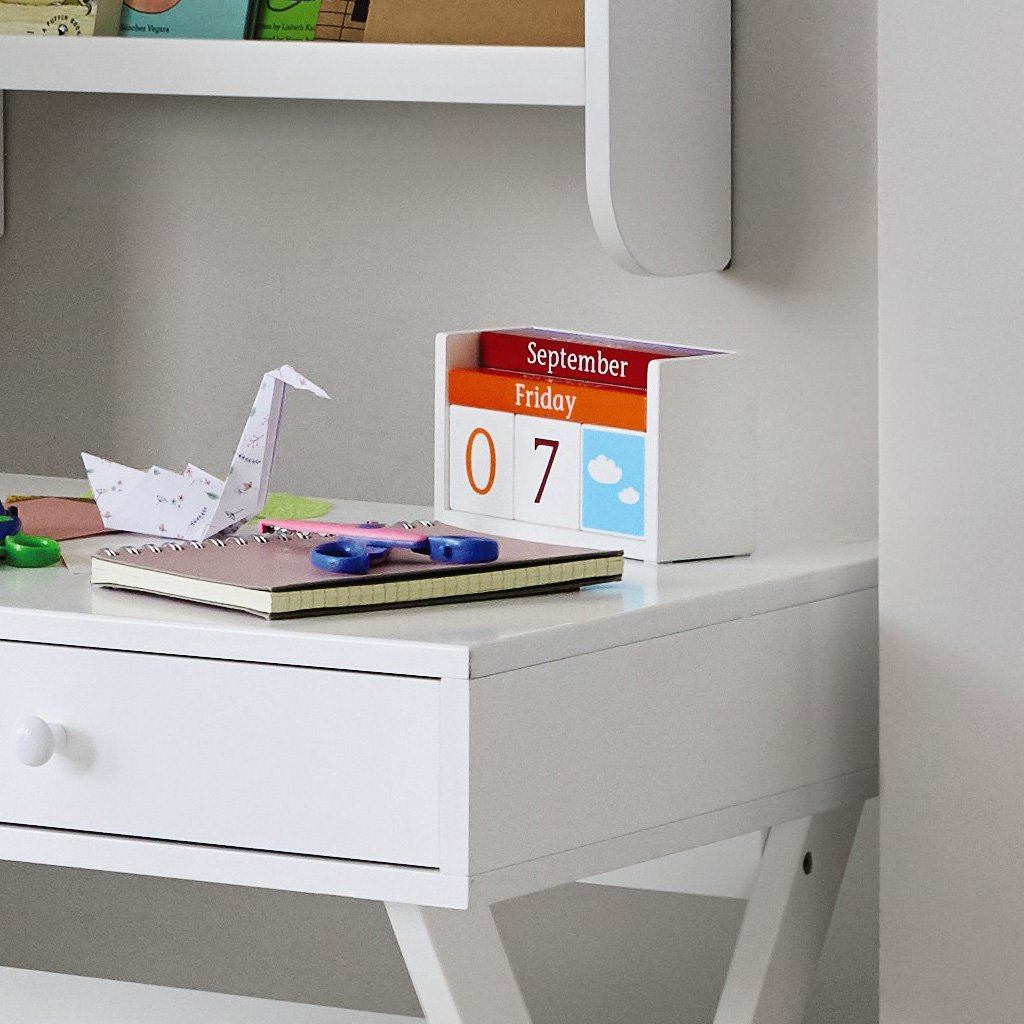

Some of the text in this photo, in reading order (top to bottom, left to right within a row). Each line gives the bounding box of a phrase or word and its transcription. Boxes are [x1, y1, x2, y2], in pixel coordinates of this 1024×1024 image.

[527, 342, 628, 377] September
[515, 383, 576, 418] Friday
[466, 427, 559, 503] 0 7
